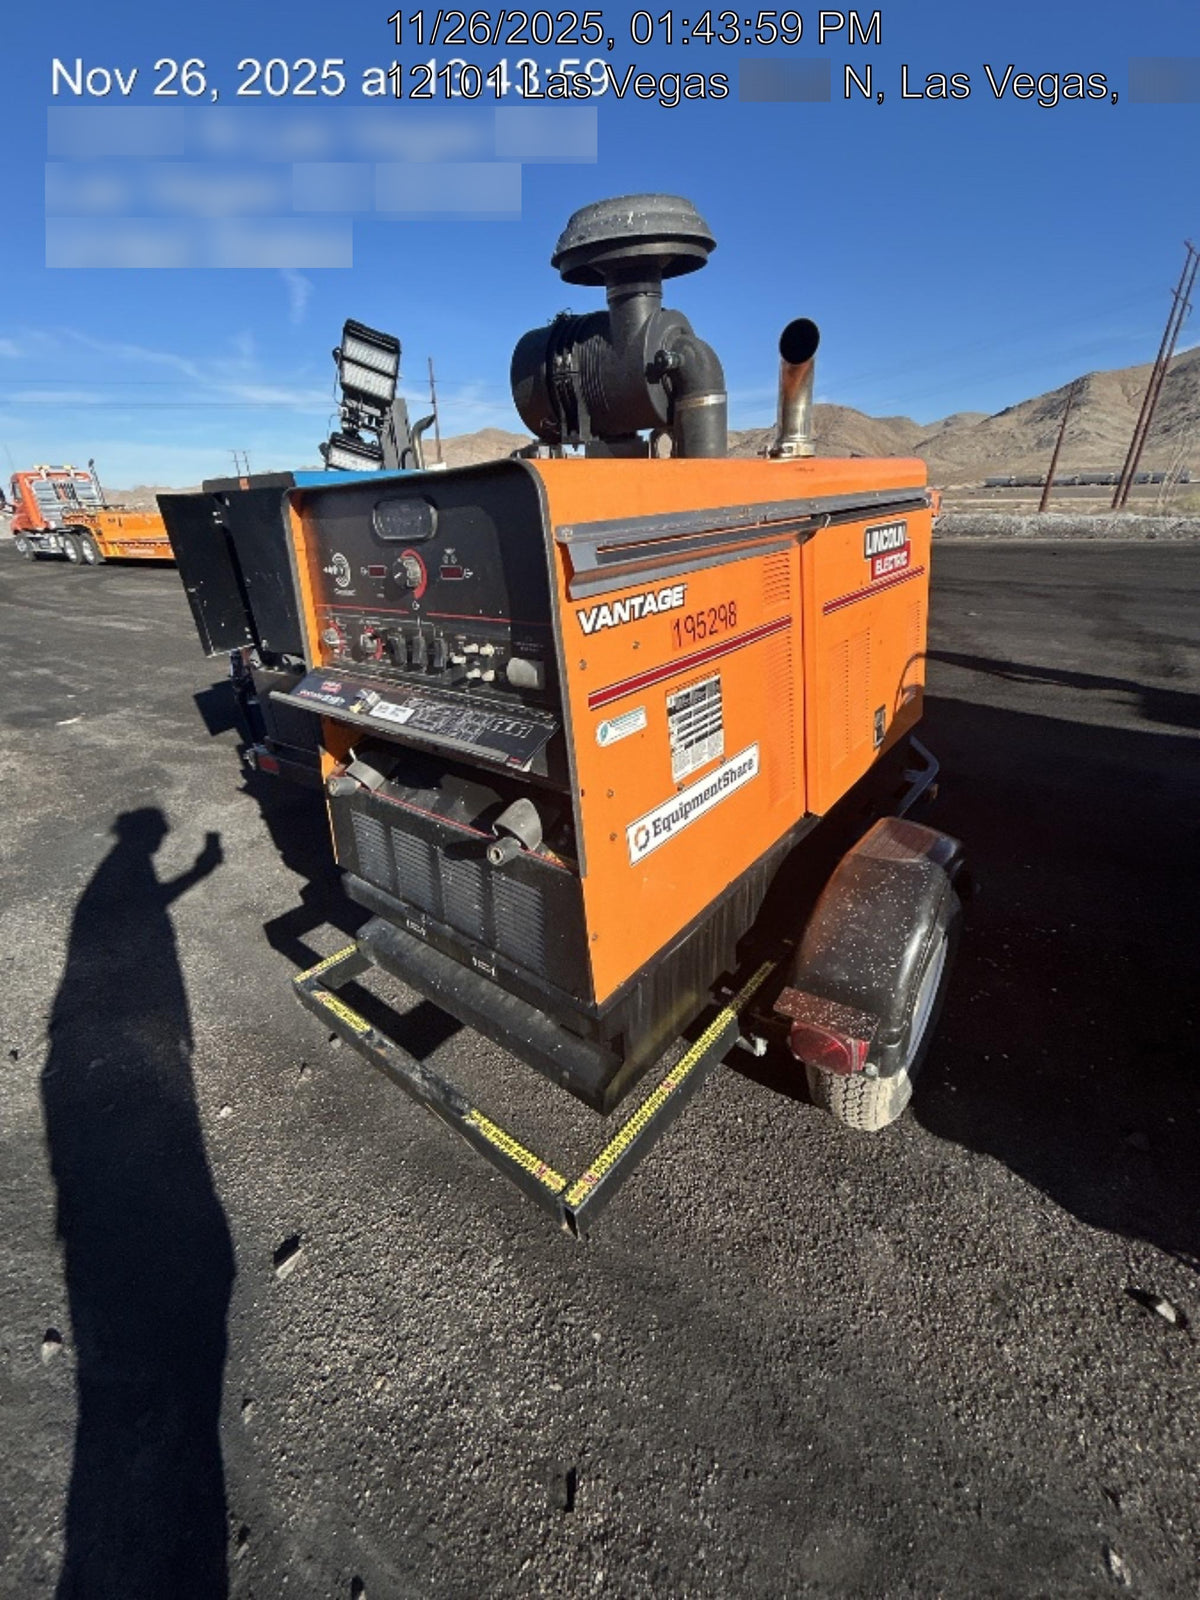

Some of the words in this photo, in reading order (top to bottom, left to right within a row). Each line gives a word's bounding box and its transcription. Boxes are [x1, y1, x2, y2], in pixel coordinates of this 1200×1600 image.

[865, 525, 906, 556] LINCOLN
[874, 551, 908, 577] ELECTRIC
[576, 584, 687, 636] VANTAGE
[673, 600, 737, 648] 195298
[651, 758, 754, 838] EquipmentShare
